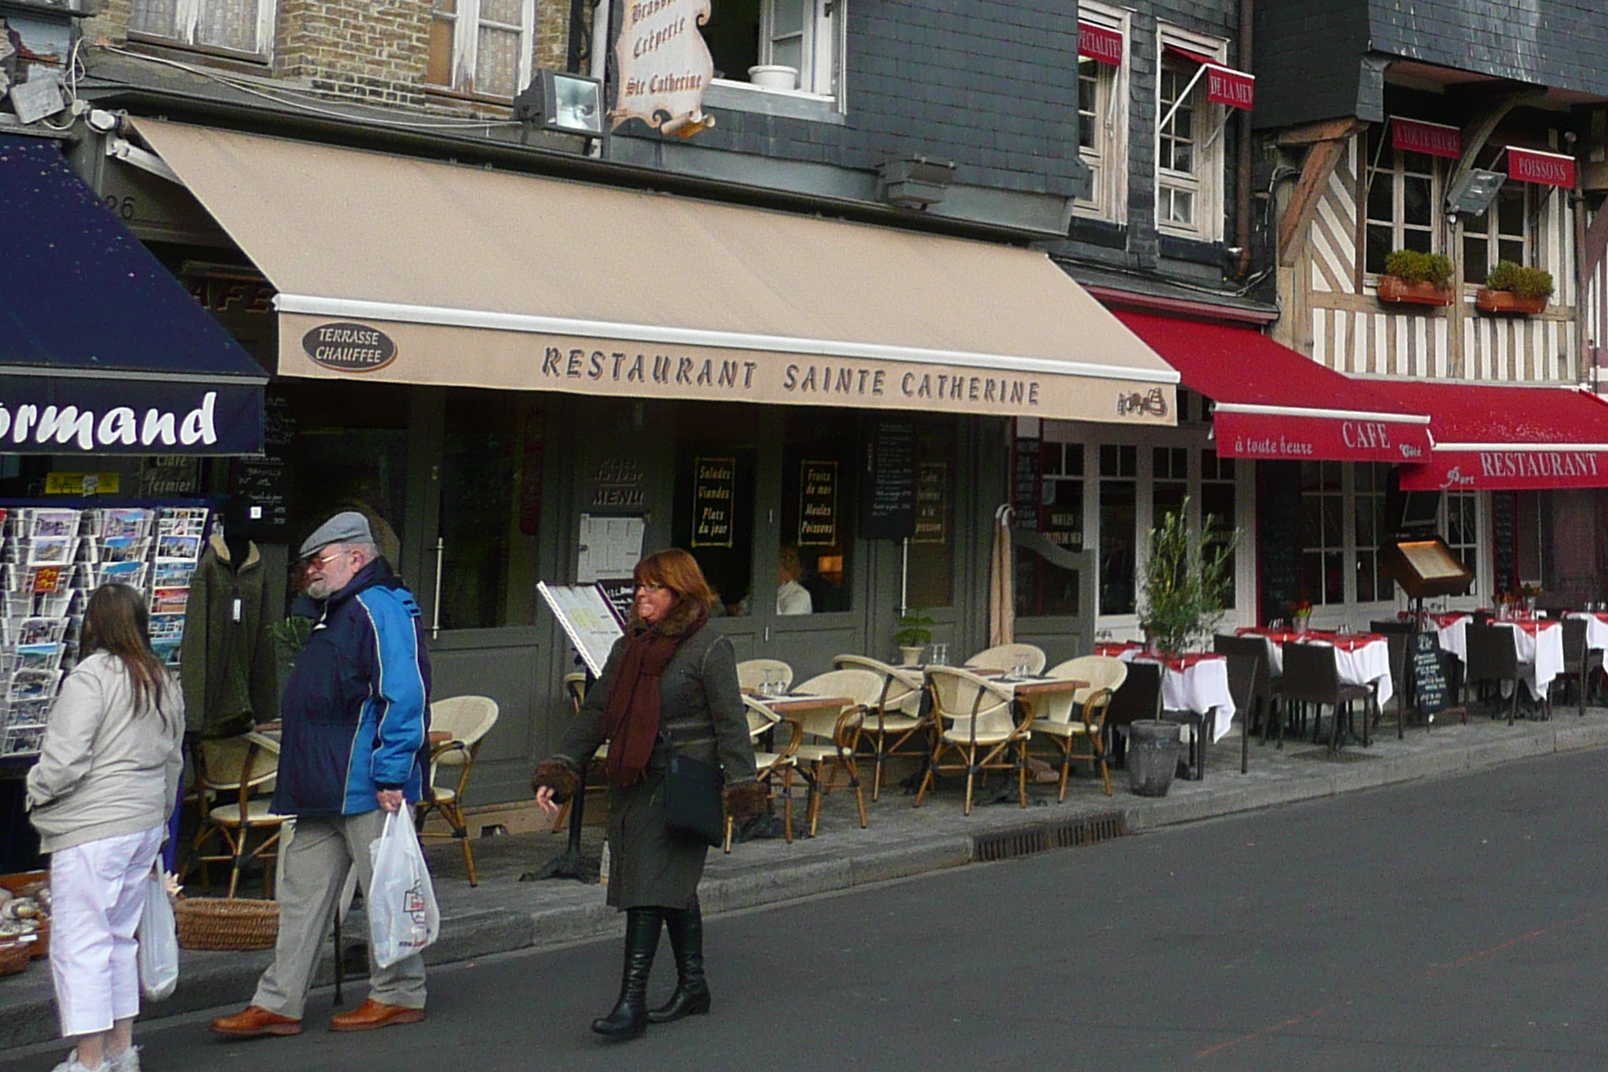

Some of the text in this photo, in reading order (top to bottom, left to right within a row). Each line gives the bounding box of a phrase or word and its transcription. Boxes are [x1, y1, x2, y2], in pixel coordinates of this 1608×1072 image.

[625, 70, 701, 98] Ste Catherine
[1210, 76, 1222, 95] DE
[1223, 81, 1235, 100] LA
[1404, 127, 1430, 148] TOUTE
[1431, 132, 1459, 153] HEURE
[1518, 157, 1566, 181] POISSONS
[318, 327, 380, 346] TERRASSE
[315, 345, 382, 363] CHAUFFEE
[542, 346, 1040, 406] RESTAURANT SAINTE CATHERINE
[1341, 421, 1390, 449] CAFE
[1235, 434, 1313, 455] à toute heure
[700, 465, 731, 479] Salades
[1478, 451, 1598, 477] RESTAURANT
[807, 468, 831, 482] Fruits
[592, 489, 645, 506] MENU
[699, 485, 730, 499] Viandes
[806, 482, 832, 495] de mer
[703, 506, 724, 521] Plats
[805, 504, 831, 516] Moules
[698, 521, 728, 538] du jour
[802, 520, 833, 534] Poissons
